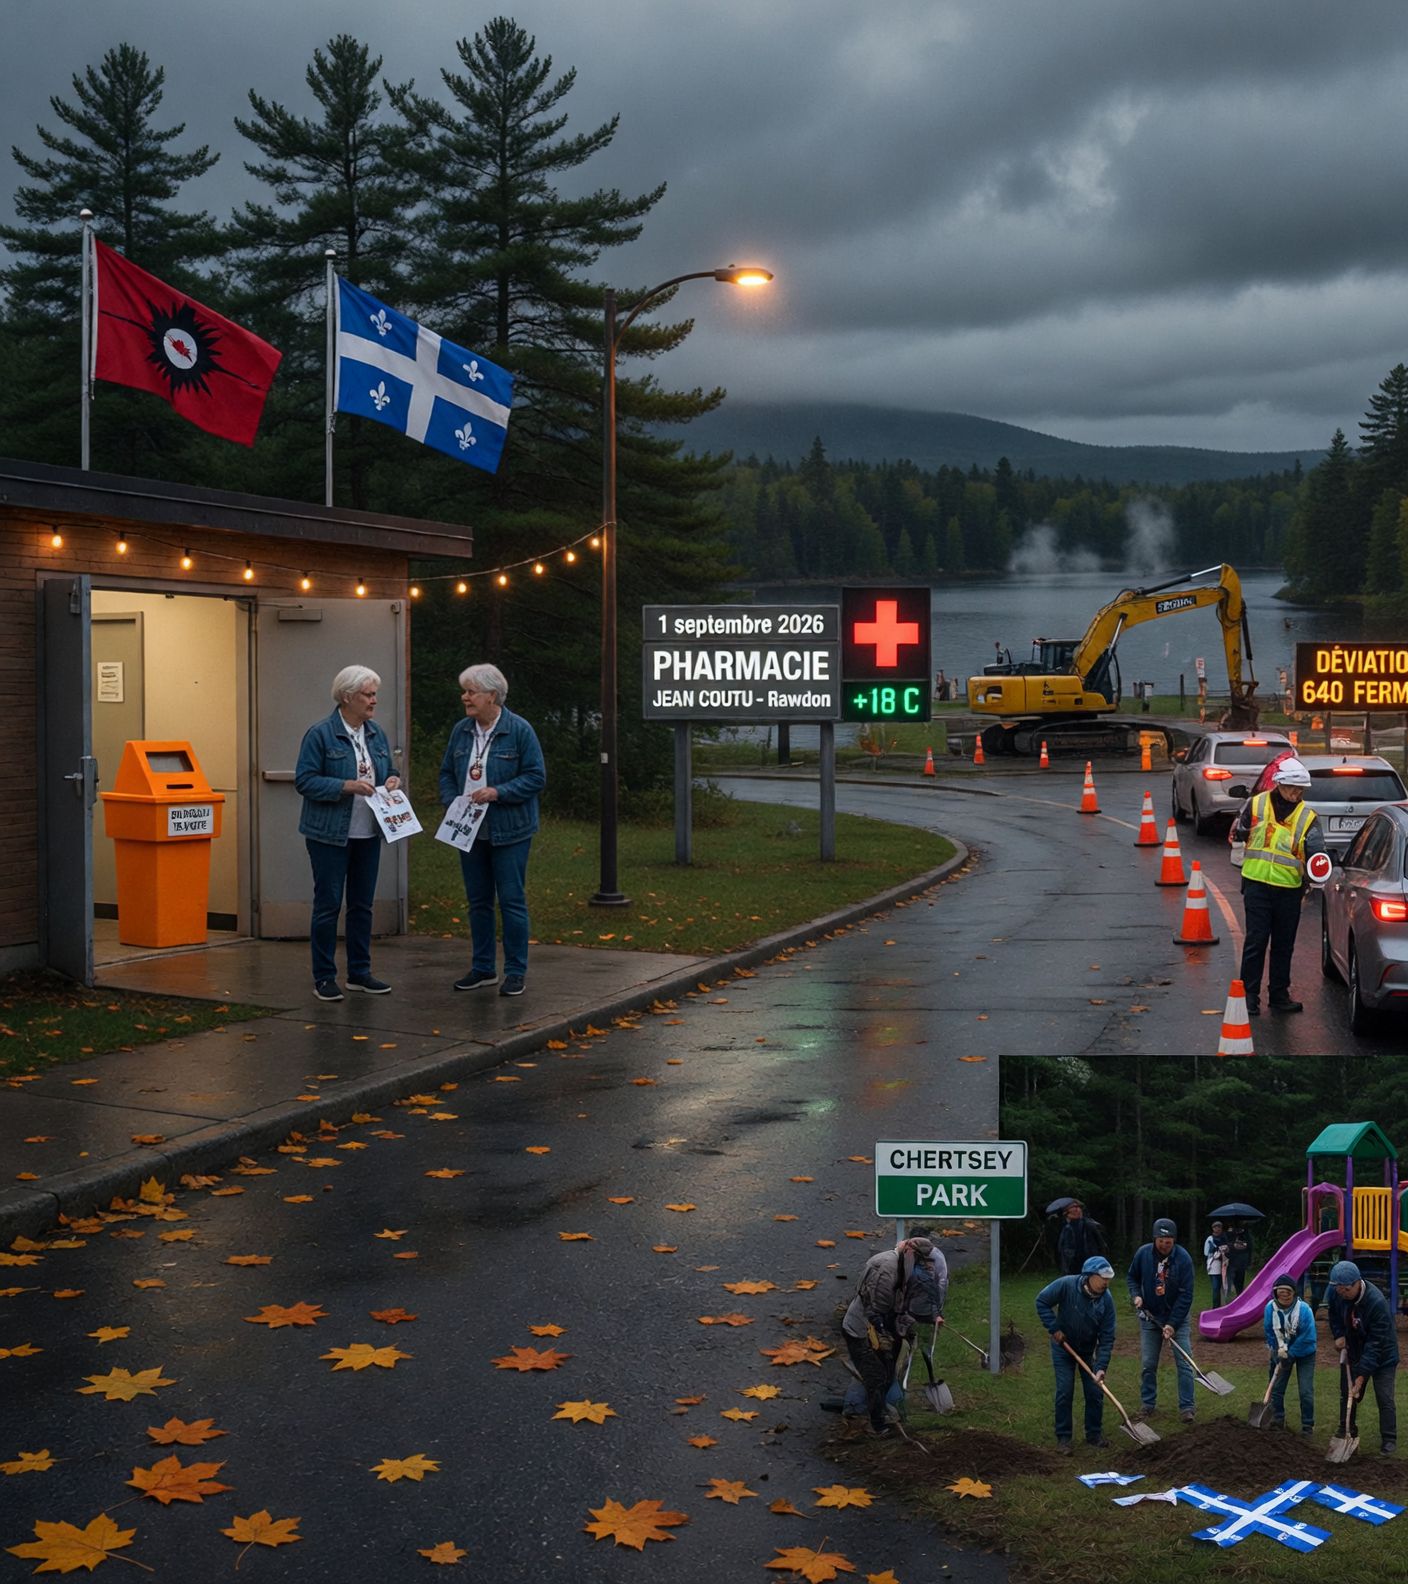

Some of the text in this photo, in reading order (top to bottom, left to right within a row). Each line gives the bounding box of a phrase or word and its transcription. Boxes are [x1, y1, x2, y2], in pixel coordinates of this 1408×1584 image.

[658, 614, 824, 638] 1 septembre 2026
[653, 650, 830, 681] PHARMACIE
[652, 690, 694, 707] JEAN
[699, 690, 753, 708] COUTU
[767, 690, 832, 708] Rawdon
[853, 688, 896, 714] +18
[1302, 680, 1344, 704] 640
[890, 1149, 1013, 1169] CHERTSEY
[916, 1183, 988, 1207] PARK
